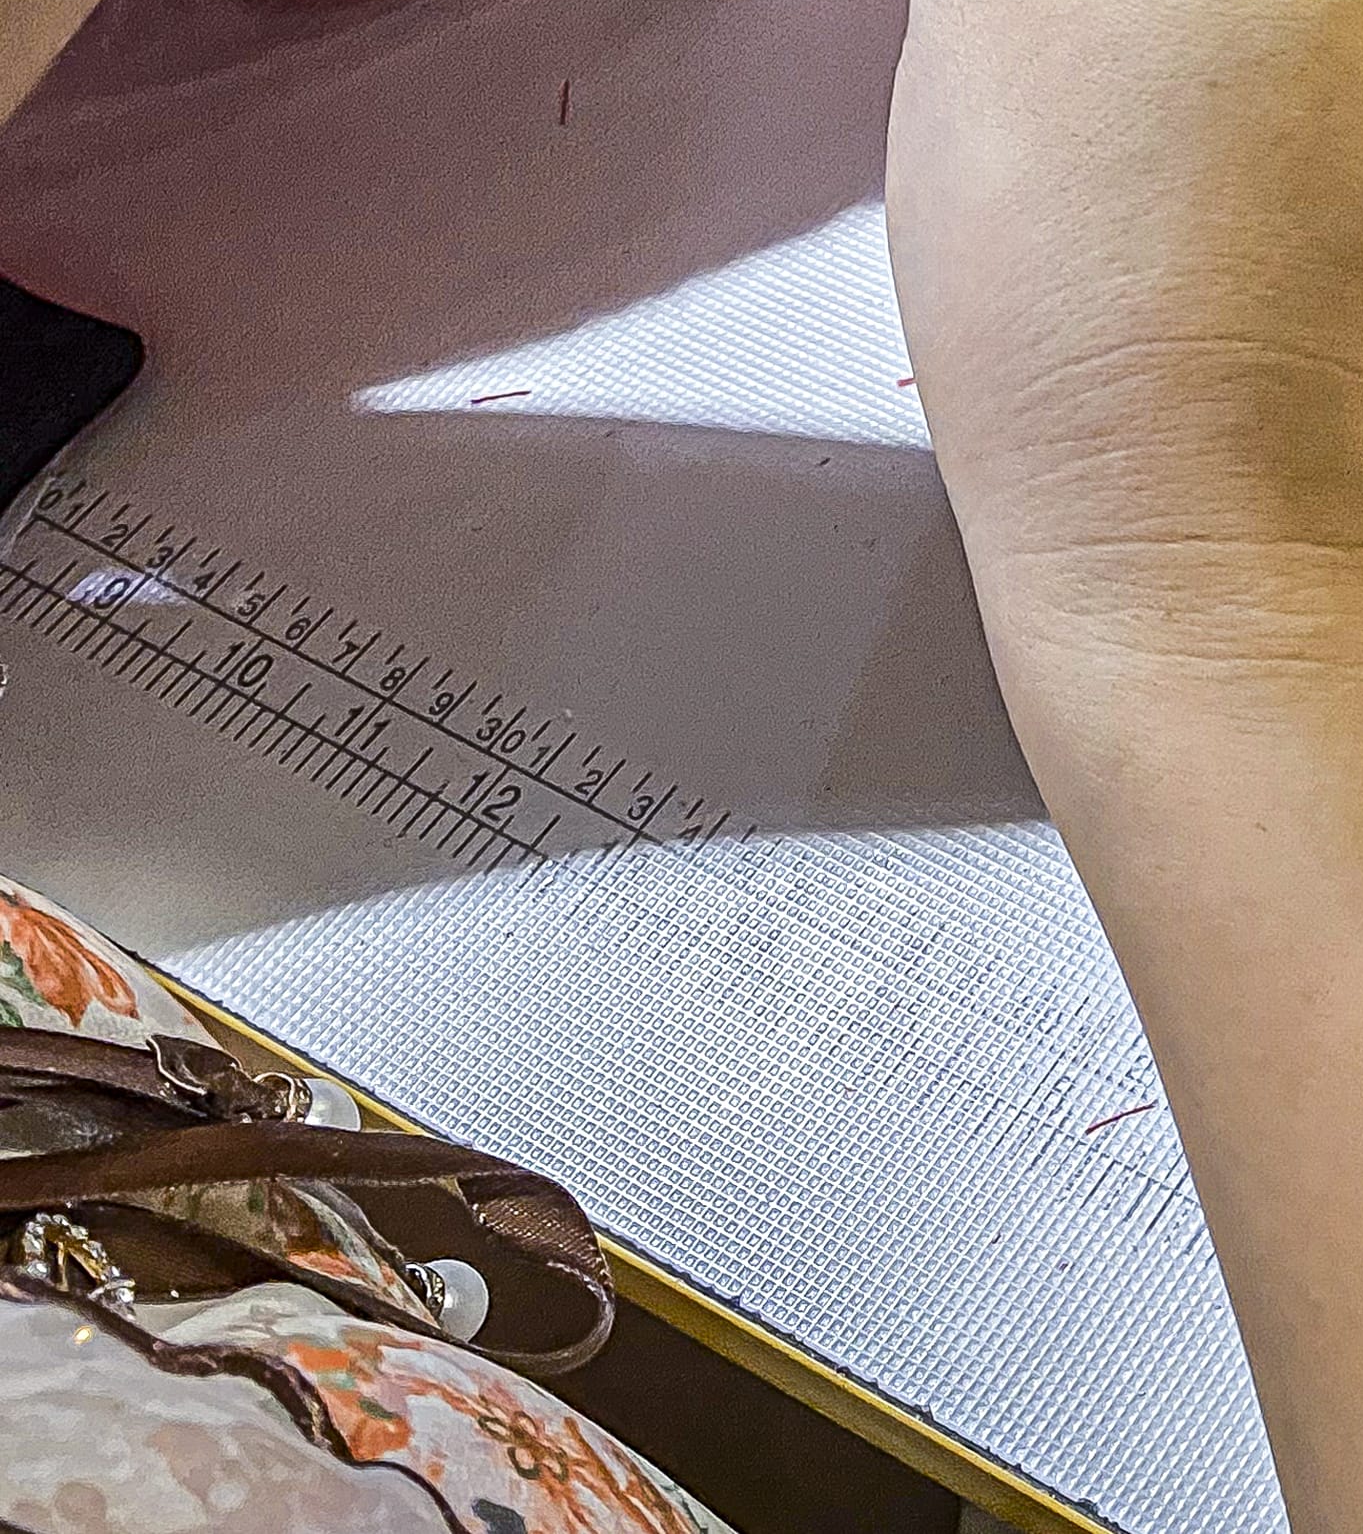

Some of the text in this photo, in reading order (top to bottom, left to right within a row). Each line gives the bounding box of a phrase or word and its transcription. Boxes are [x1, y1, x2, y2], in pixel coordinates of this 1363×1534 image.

[101, 524, 129, 547] 2
[146, 547, 174, 569] 3
[193, 571, 217, 592] 4
[237, 593, 266, 616] 5
[285, 617, 312, 641] 6
[332, 640, 360, 664] 7
[379, 667, 406, 692] 8
[428, 692, 455, 716] 9
[529, 745, 552, 768] 1
[574, 769, 604, 796] 2
[627, 795, 655, 821] 3
[213, 641, 275, 688] 10
[459, 770, 522, 822] 12
